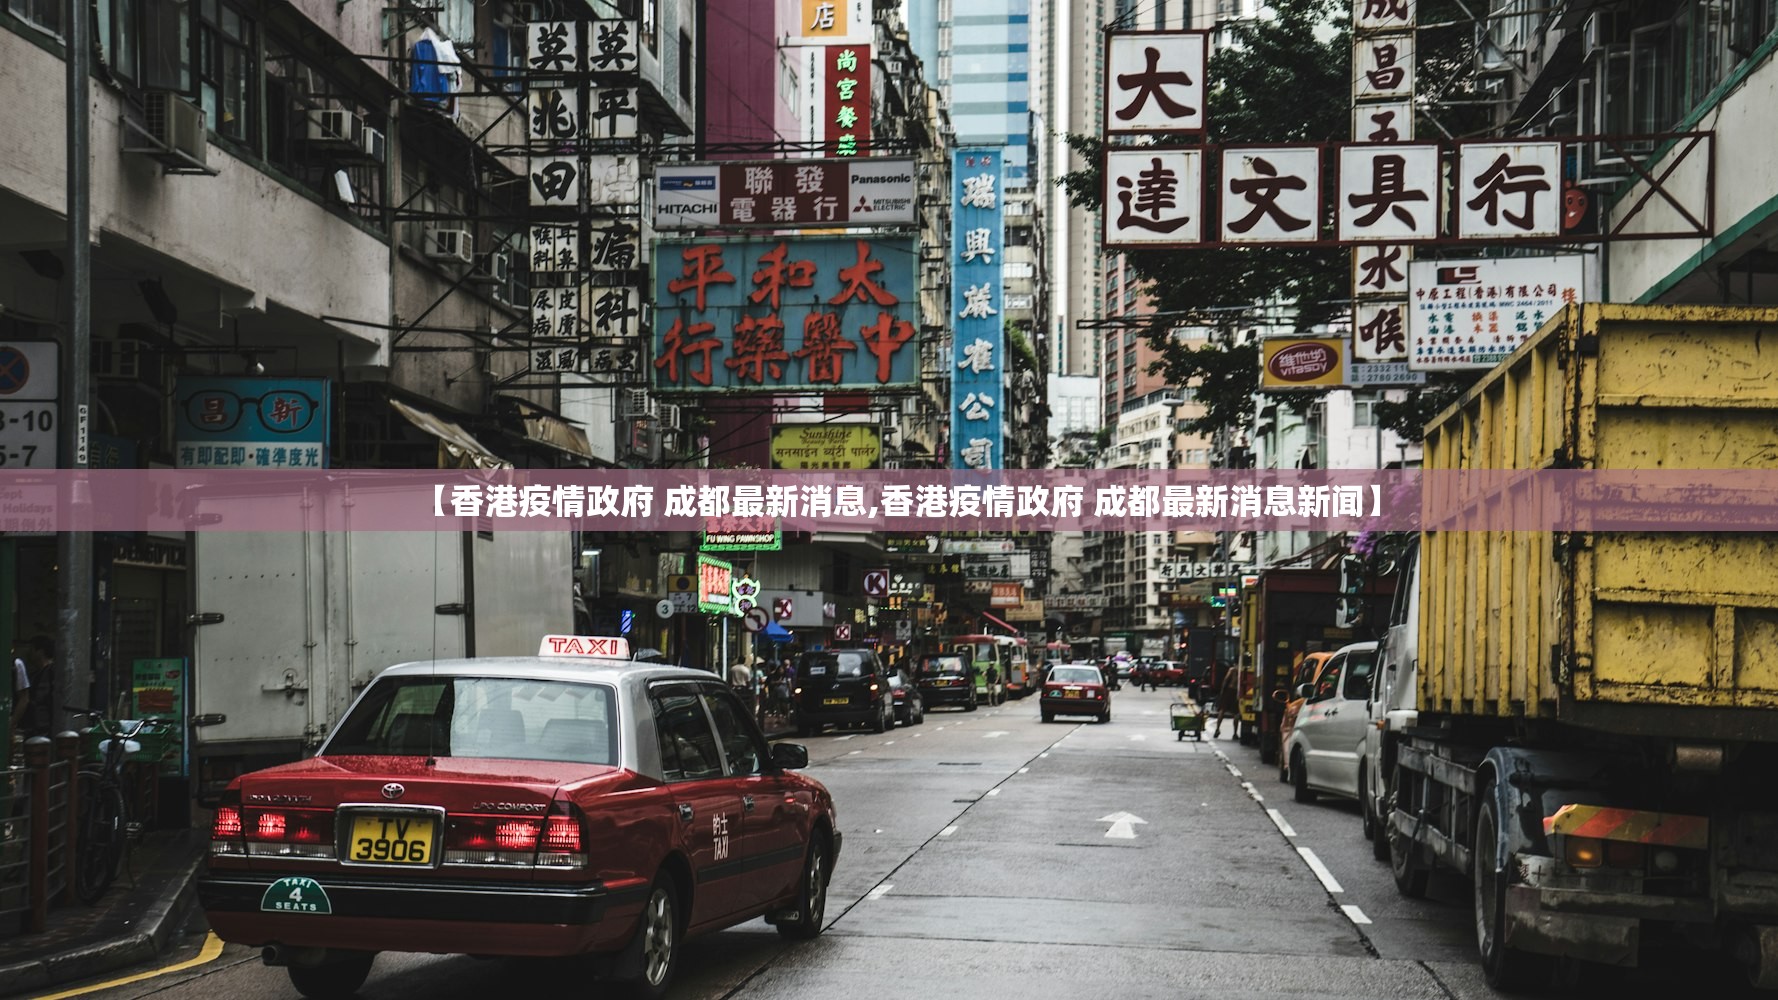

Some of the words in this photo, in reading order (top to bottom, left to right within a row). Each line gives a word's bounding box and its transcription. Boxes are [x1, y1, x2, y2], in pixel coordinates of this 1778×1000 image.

[811, 2, 834, 30] 店
[1115, 46, 1197, 121] 大
[745, 165, 824, 195] 聯發
[851, 174, 911, 184] Panasonic
[658, 203, 718, 215] HITACHI
[730, 196, 838, 223] 電器行
[1279, 348, 1327, 367] 維他奶
[799, 427, 852, 439] Sunshine
[706, 535, 715, 543] FU
[717, 535, 735, 543] WING
[736, 534, 774, 543] PAWNSHOP
[868, 574, 883, 593] K
[662, 604, 669, 614] 3
[548, 637, 619, 655] TAXI
[497, 802, 547, 812] COMFORT
[378, 818, 411, 840] TV
[713, 811, 728, 836] 的士
[356, 839, 426, 862] 3906
[713, 836, 729, 860] TAXI
[283, 878, 311, 888] TAXI
[289, 888, 303, 902] 4
[275, 901, 317, 911] SEATS
